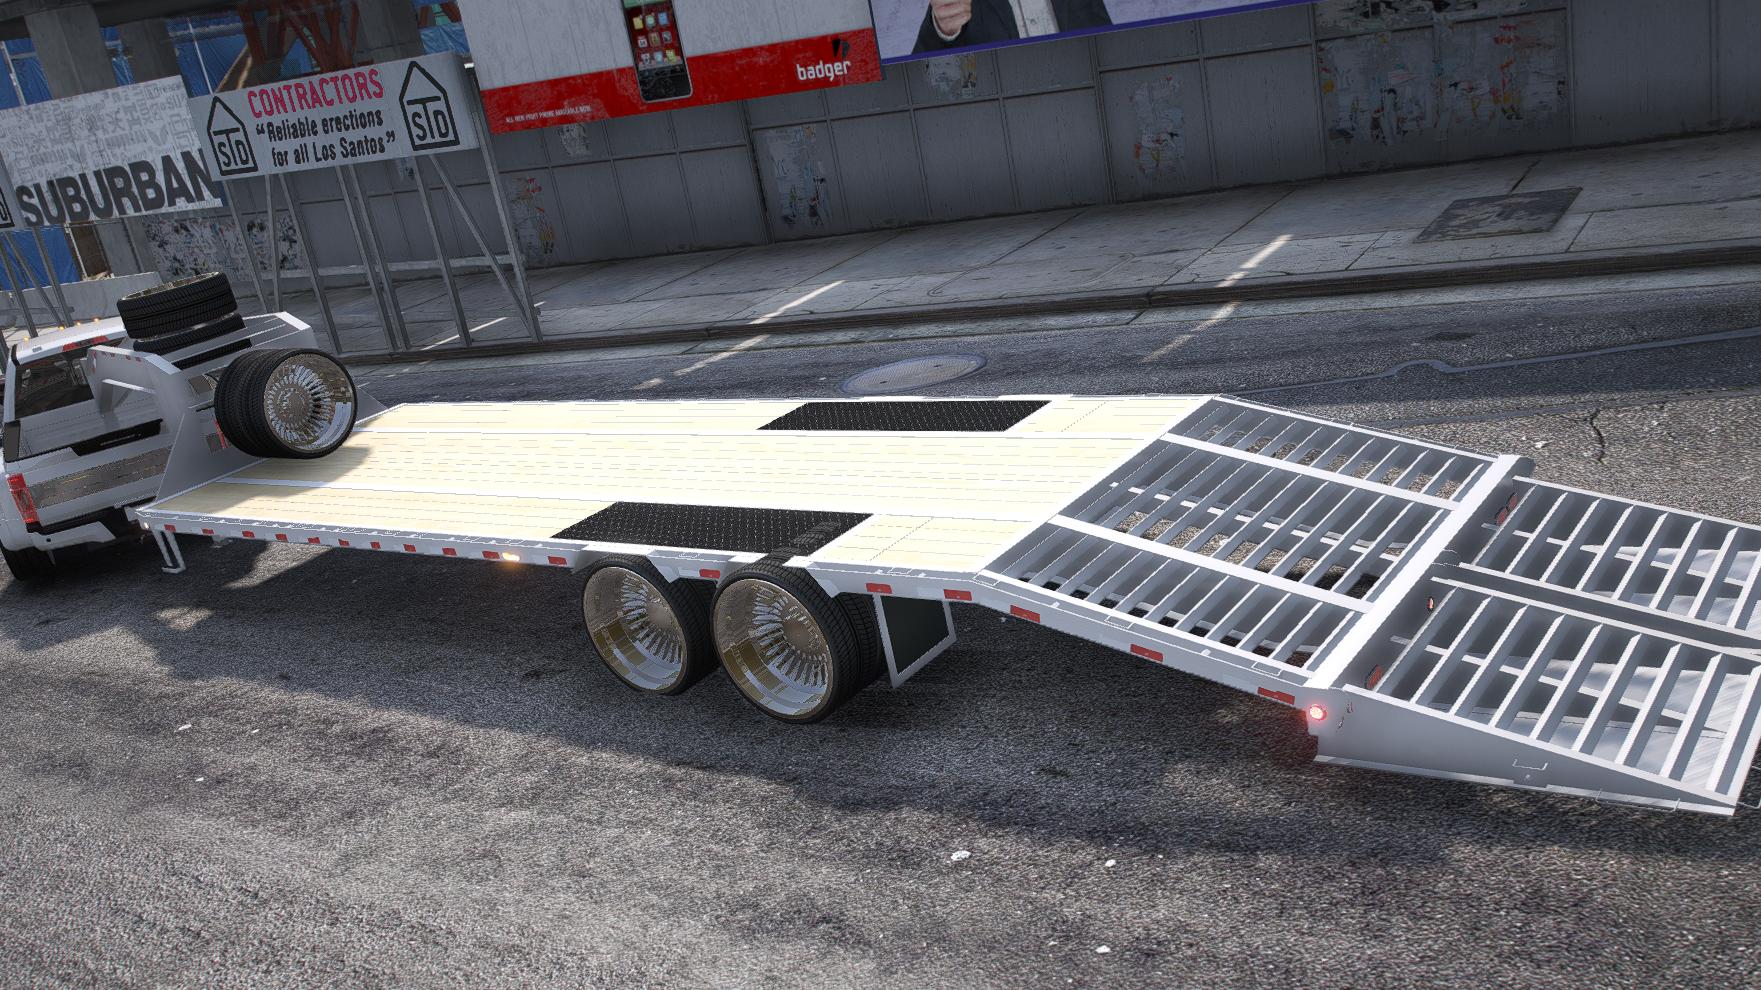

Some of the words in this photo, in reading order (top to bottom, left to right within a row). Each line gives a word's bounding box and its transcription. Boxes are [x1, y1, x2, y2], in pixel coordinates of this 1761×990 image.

[796, 60, 851, 82] badger
[247, 68, 384, 119] CONTRACTORS
[321, 109, 384, 135] erections
[406, 96, 450, 142] STD
[213, 127, 249, 168] STD
[271, 147, 289, 167] for
[293, 143, 310, 165] all
[312, 141, 337, 162] Los
[15, 148, 221, 227] SUBURBAN
